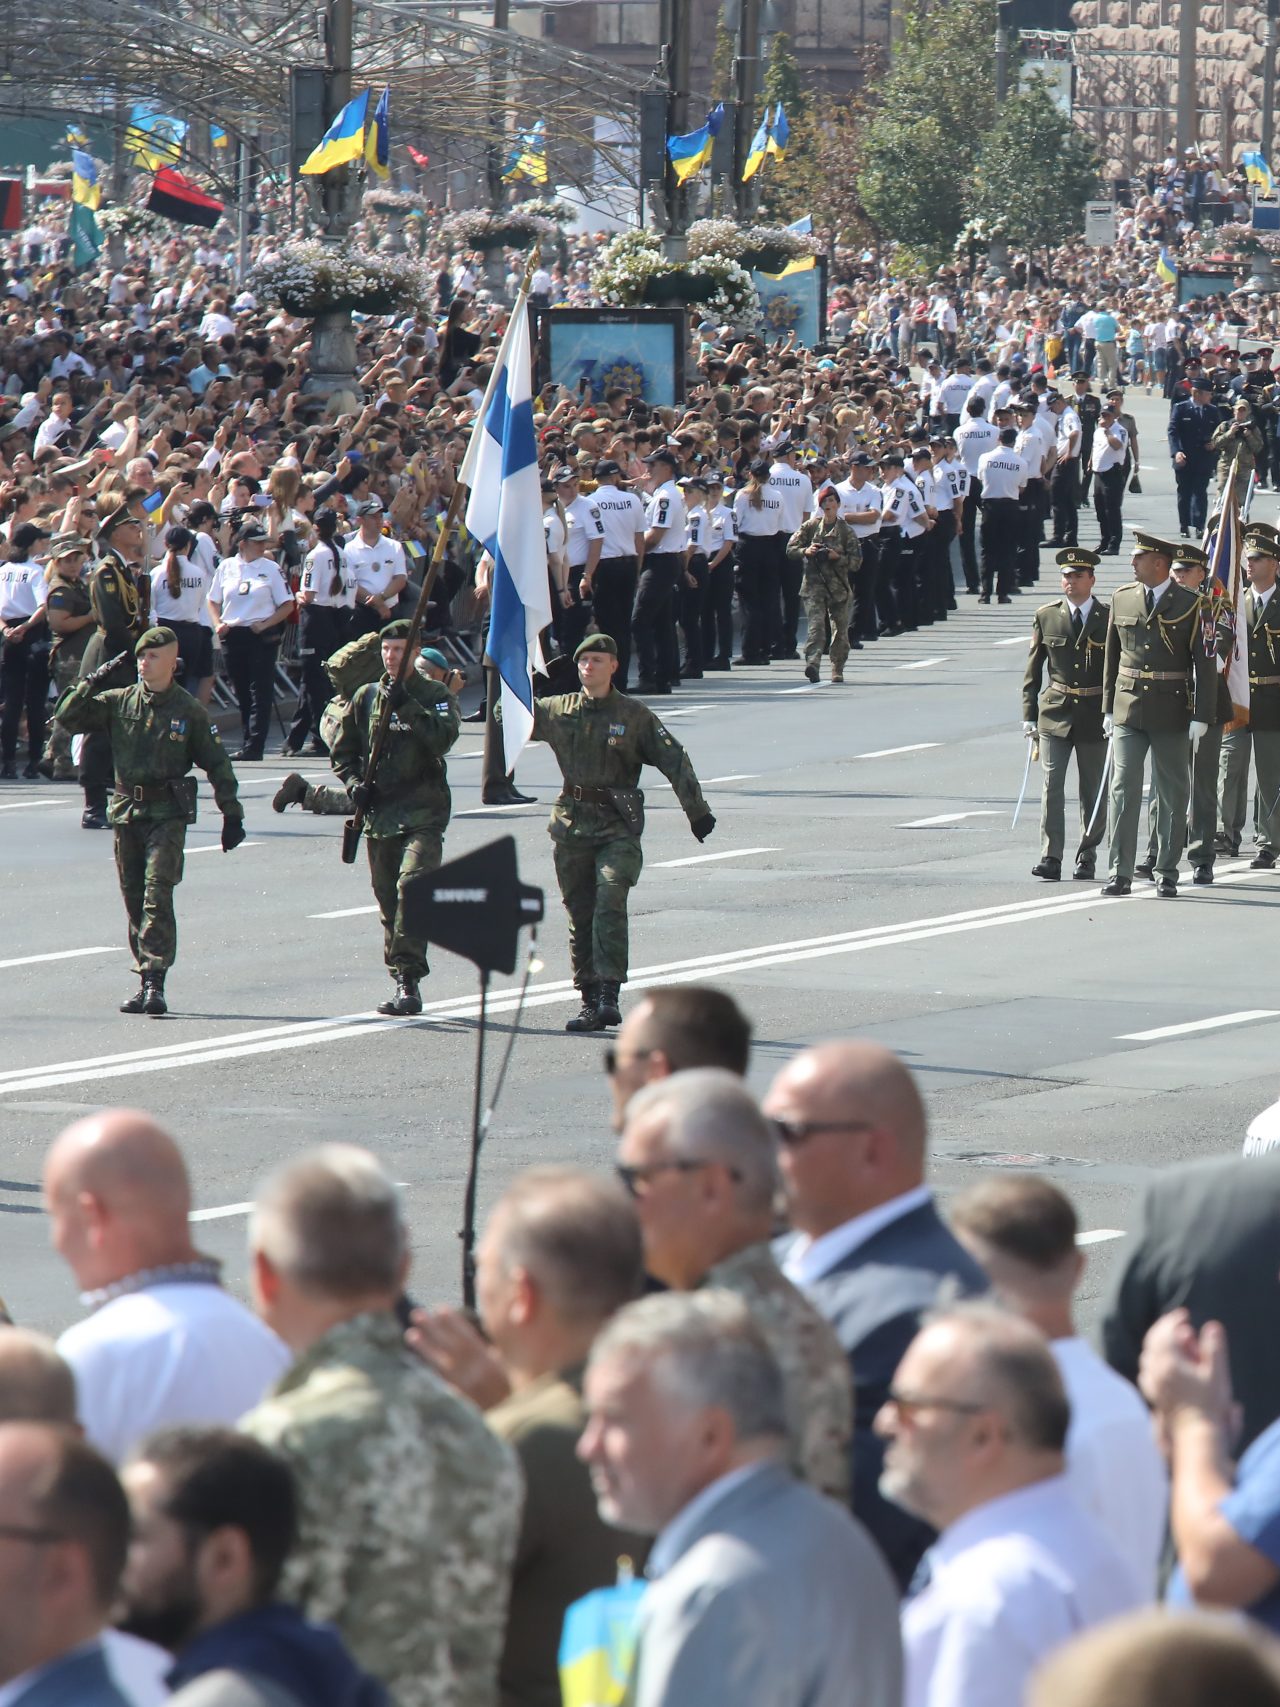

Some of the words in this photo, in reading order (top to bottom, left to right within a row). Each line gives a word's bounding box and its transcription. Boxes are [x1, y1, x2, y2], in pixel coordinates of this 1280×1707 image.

[960, 430, 991, 439] ПОЛІЦІЯ
[987, 460, 1020, 472] ПОЛІЦІЯ
[769, 477, 800, 487] ОЛІЦІЯ
